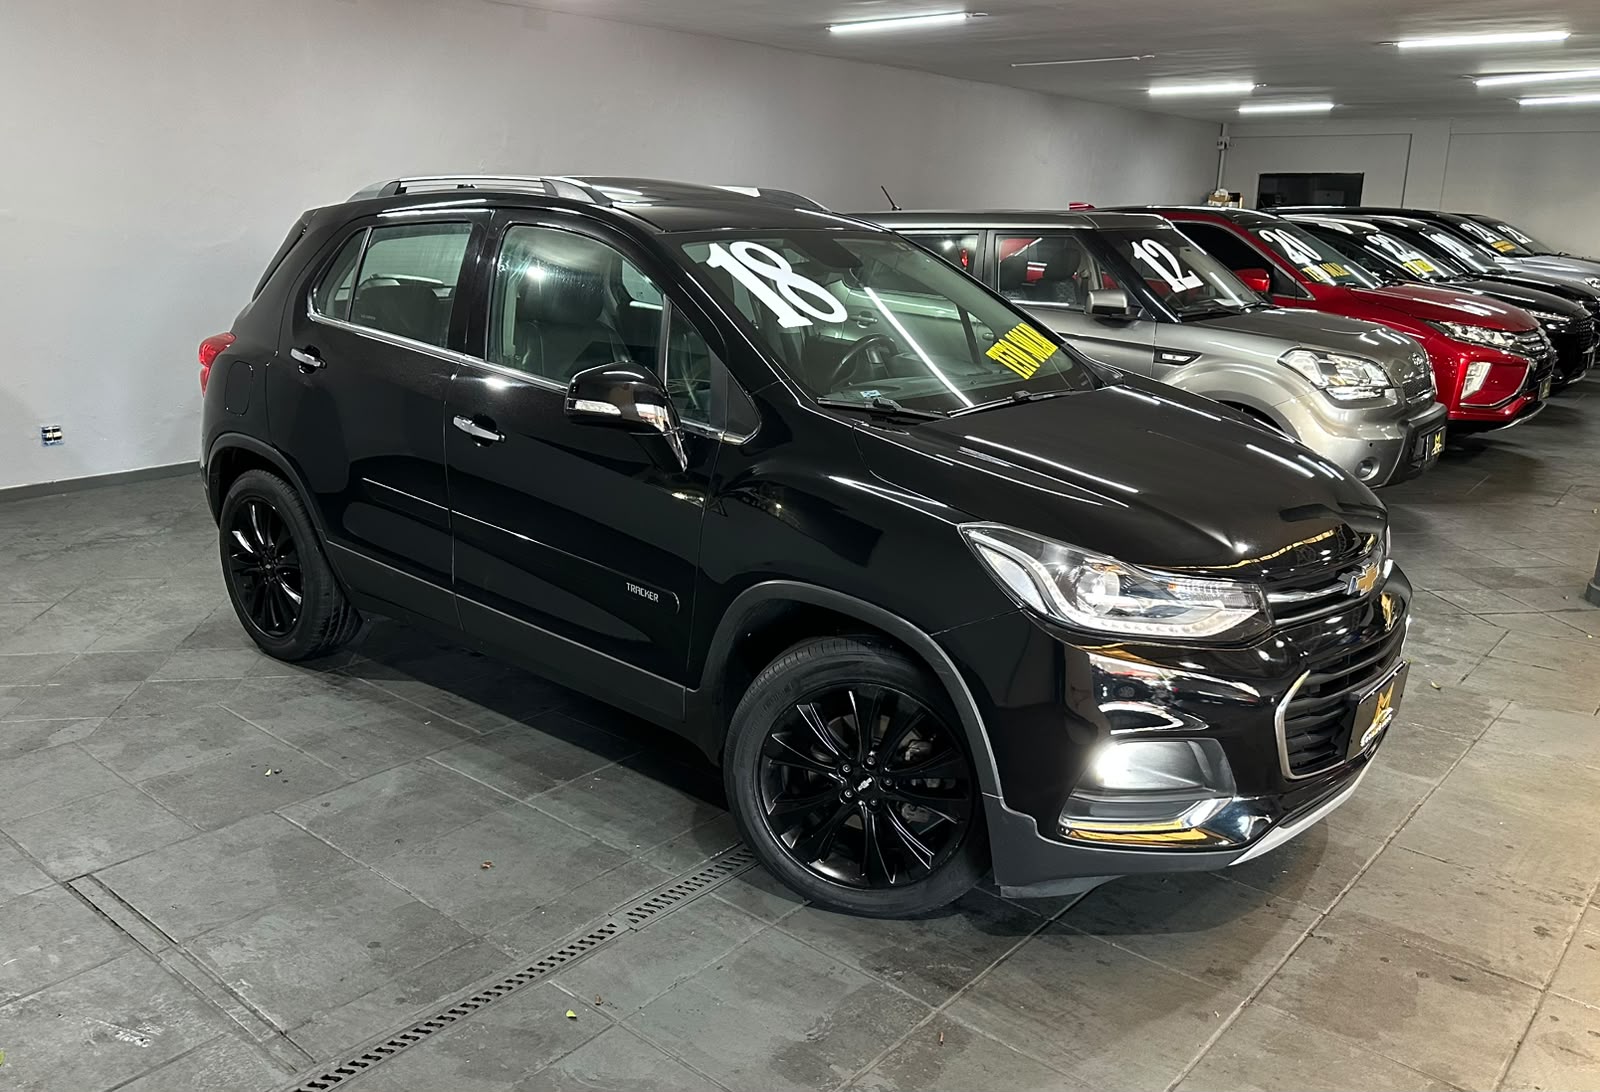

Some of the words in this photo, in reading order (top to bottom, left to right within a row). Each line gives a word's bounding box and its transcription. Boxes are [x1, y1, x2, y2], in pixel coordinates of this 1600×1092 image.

[1131, 239, 1204, 293] 12
[1259, 229, 1322, 264] 20
[706, 241, 848, 328] 18
[626, 582, 659, 603] TRACKER
